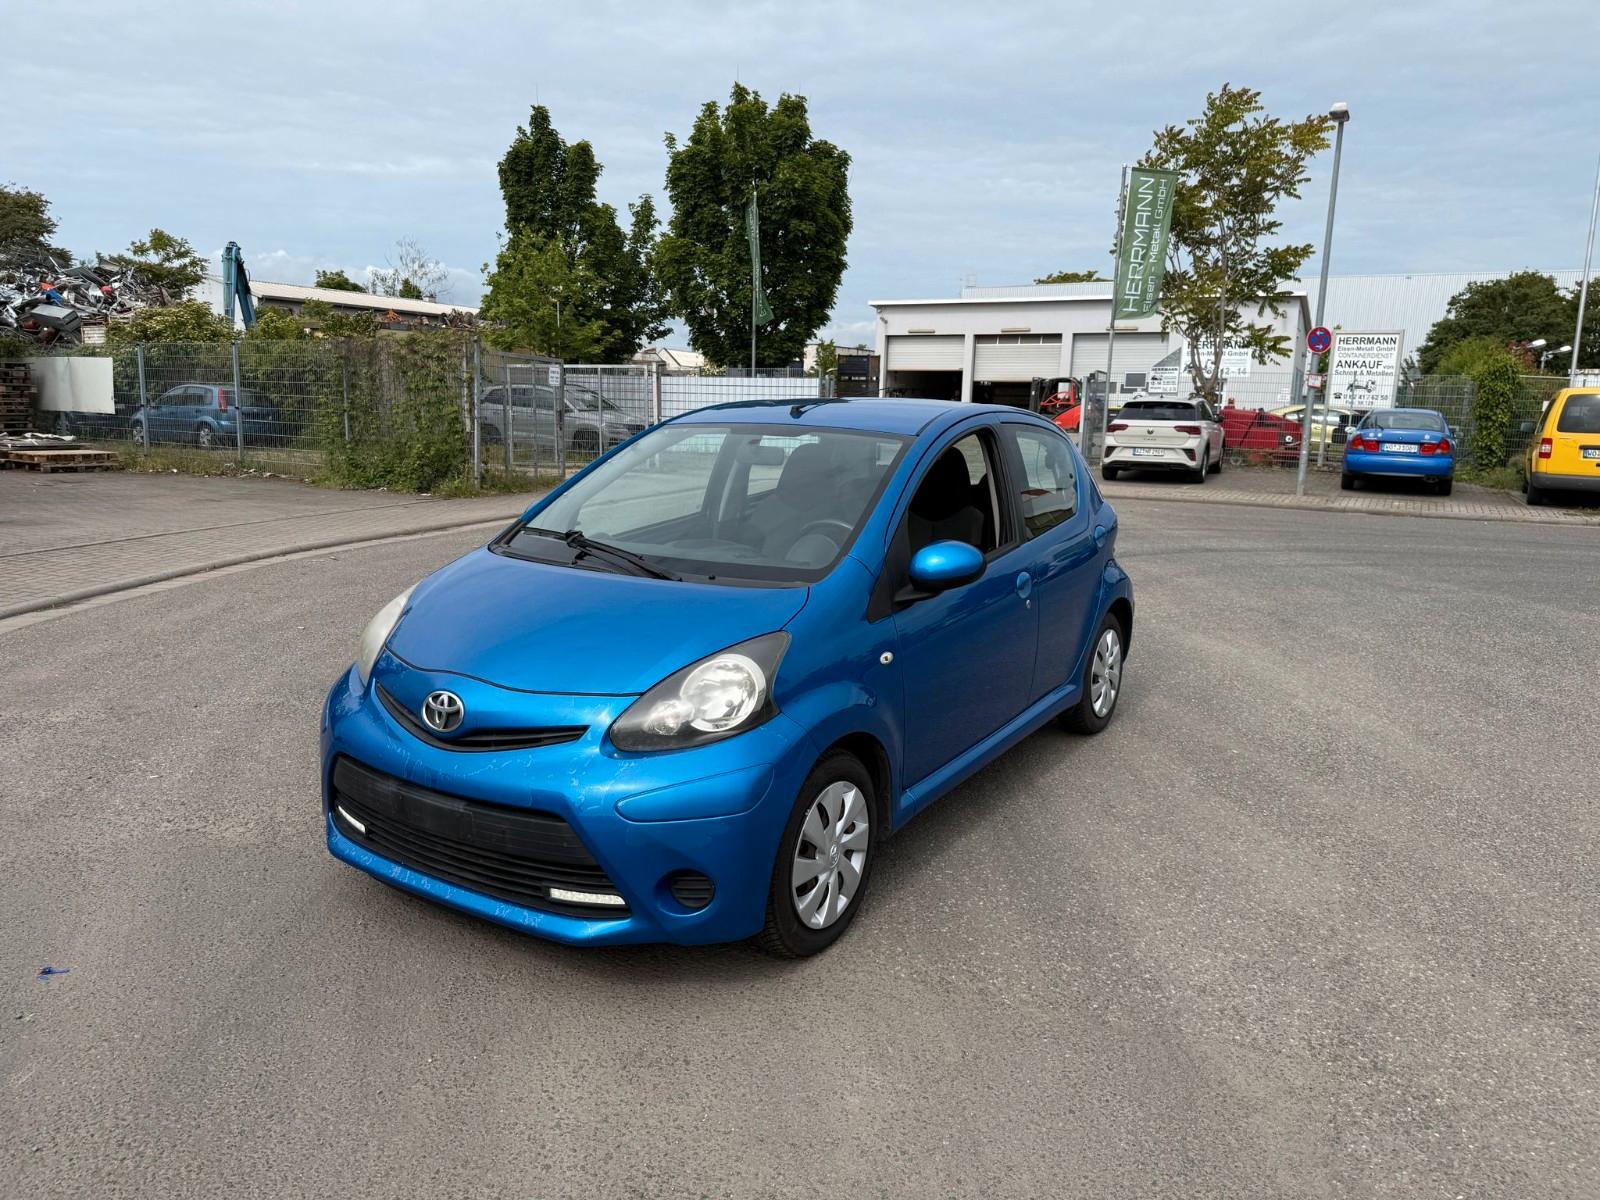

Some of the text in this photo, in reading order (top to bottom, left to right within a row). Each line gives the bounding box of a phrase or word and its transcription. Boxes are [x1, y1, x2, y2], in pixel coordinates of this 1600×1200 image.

[1154, 179, 1167, 219] GmbH
[1122, 176, 1155, 312] HERRMANN
[1149, 222, 1161, 262] Metall
[1143, 276, 1156, 313] Eisen
[1338, 336, 1397, 345] HERRMANN
[1336, 360, 1383, 369] ANKAUF
